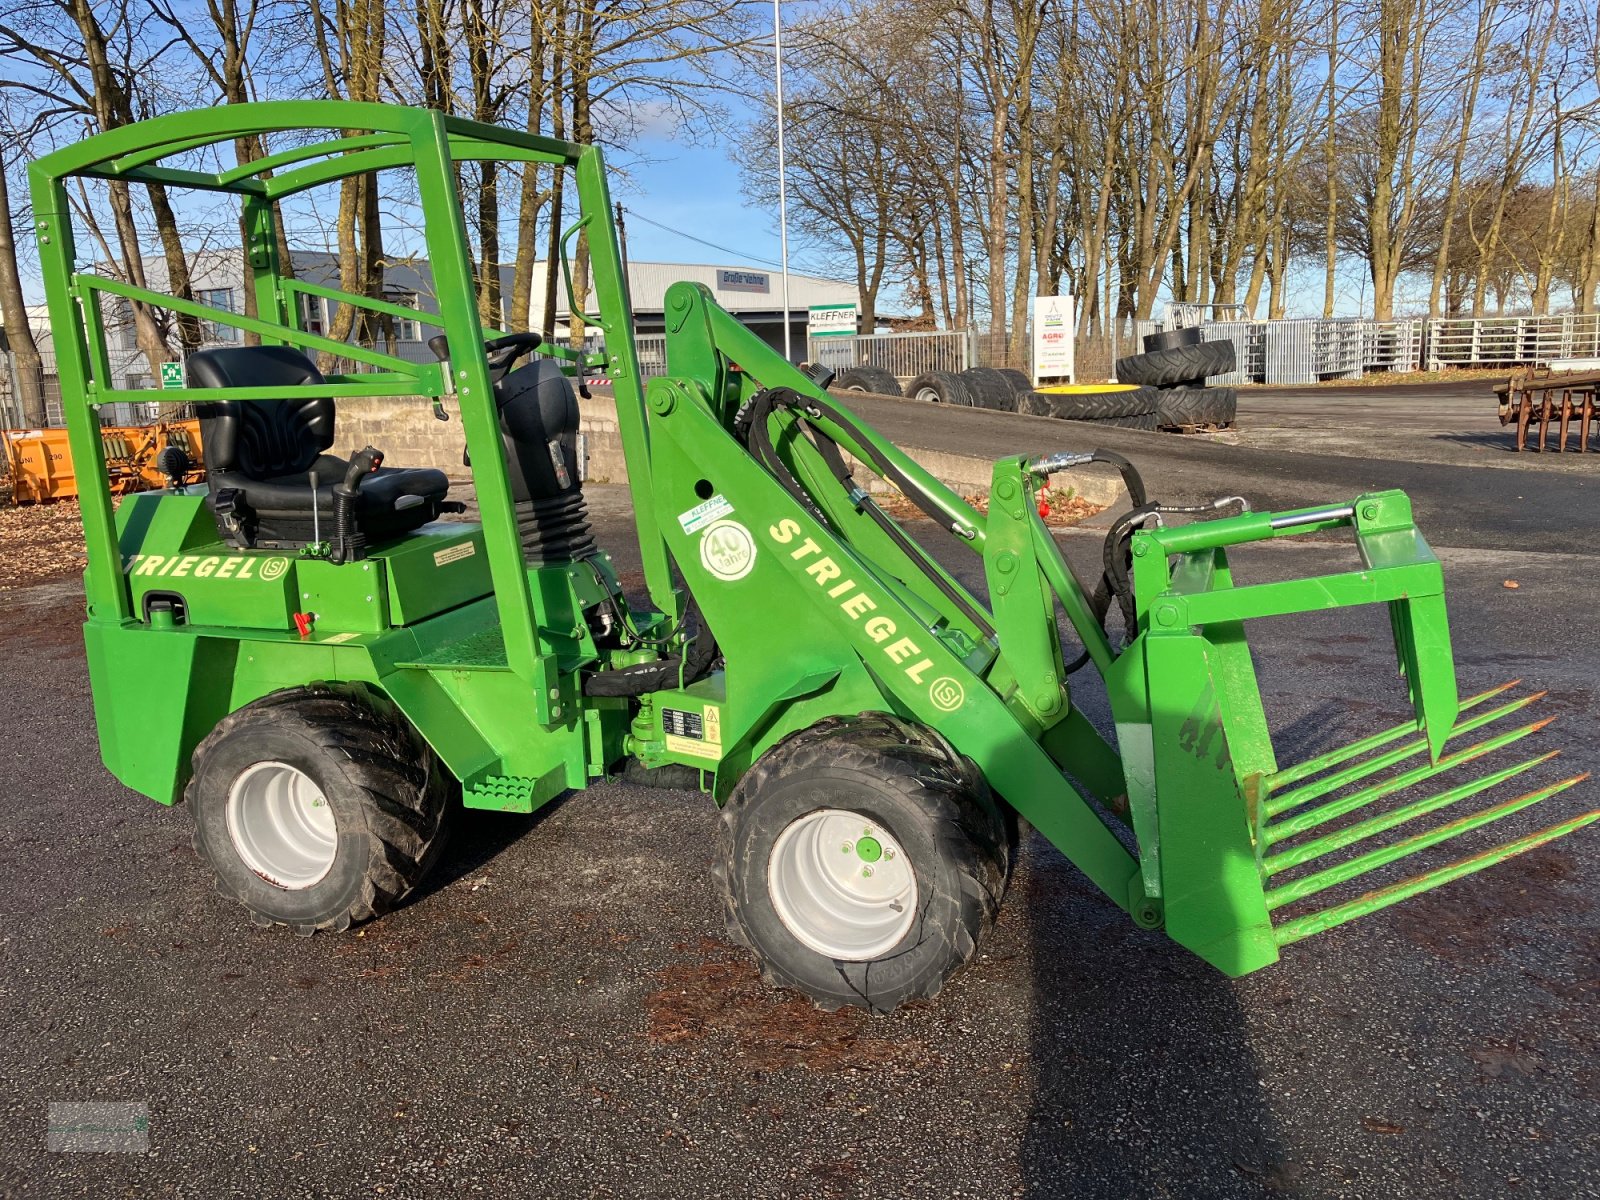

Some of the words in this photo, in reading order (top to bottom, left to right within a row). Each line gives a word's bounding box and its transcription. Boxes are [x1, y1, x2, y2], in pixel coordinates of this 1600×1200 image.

[810, 310, 855, 321] KLEFFNER
[19, 457, 33, 465] UNI
[49, 453, 63, 461] 290
[691, 495, 726, 517] KLEFFNE
[711, 529, 740, 557] 40
[121, 554, 257, 579] TRIEGEL
[718, 550, 749, 570] Jahre
[769, 518, 934, 685] STRIEGEL
